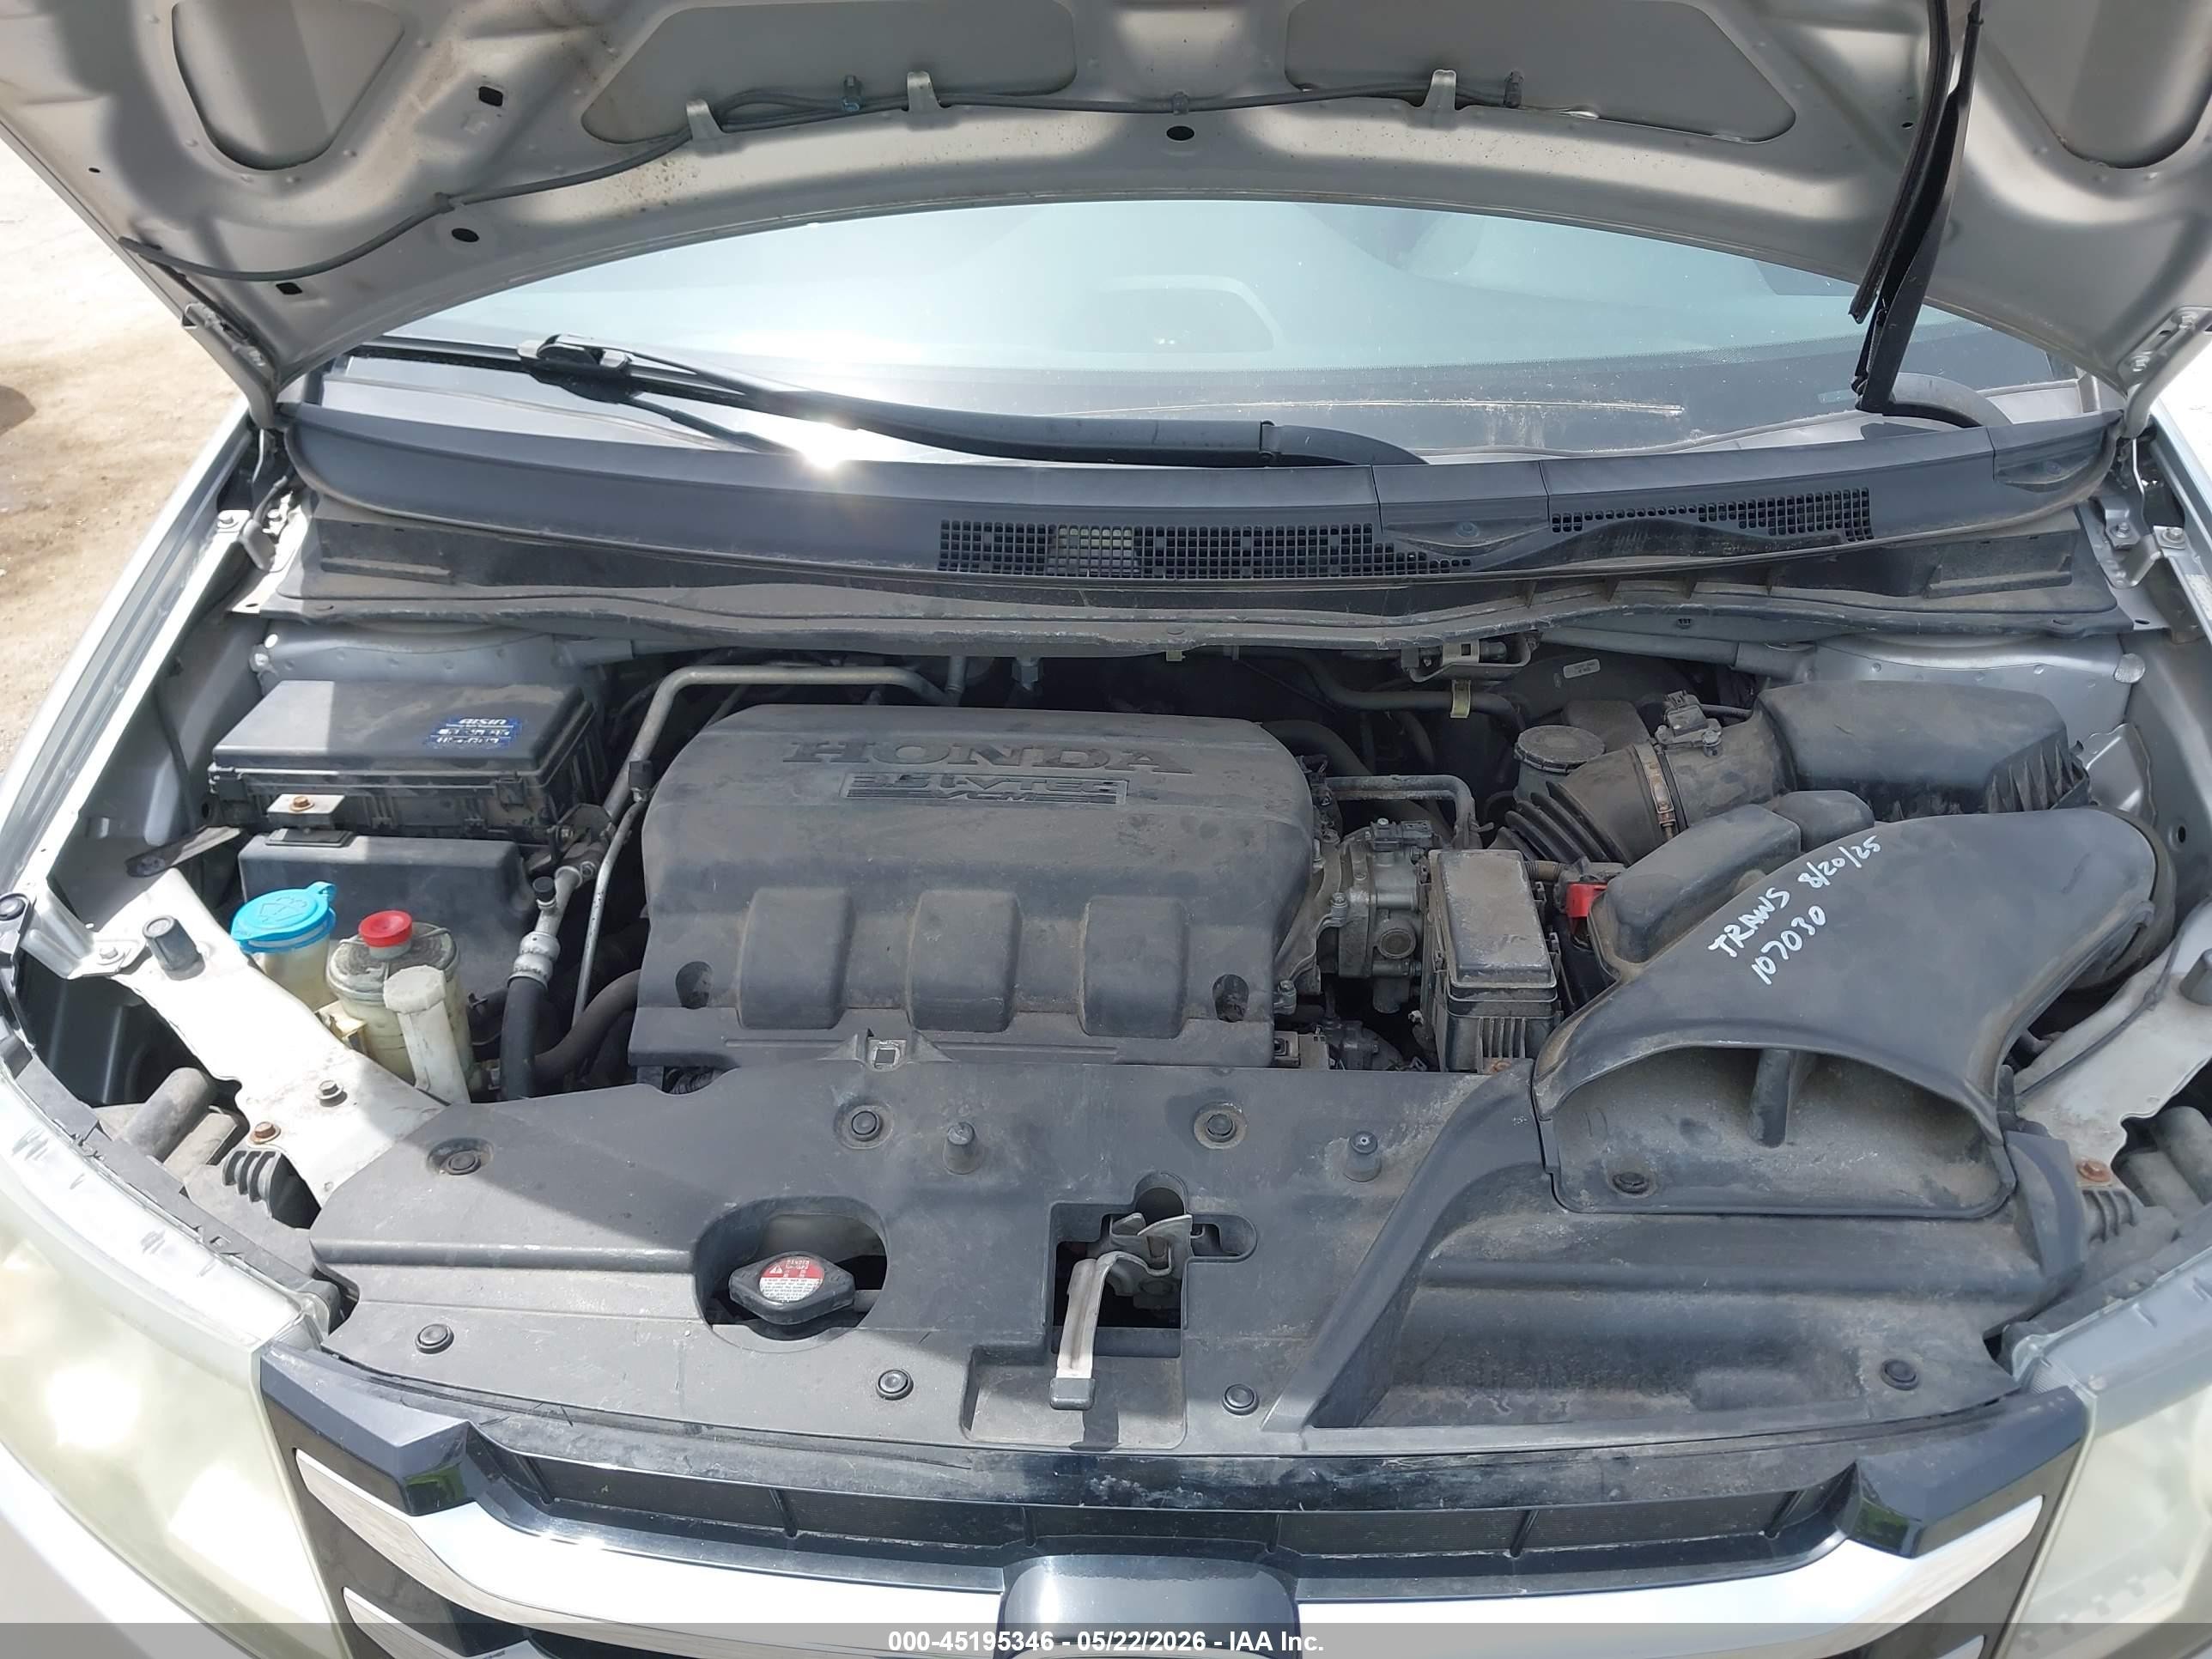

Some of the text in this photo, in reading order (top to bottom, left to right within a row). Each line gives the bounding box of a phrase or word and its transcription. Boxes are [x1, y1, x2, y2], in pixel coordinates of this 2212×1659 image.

[782, 741, 1193, 775] HONDA
[1797, 835, 1881, 889] 8/20/25
[1751, 905, 1827, 986] 107030
